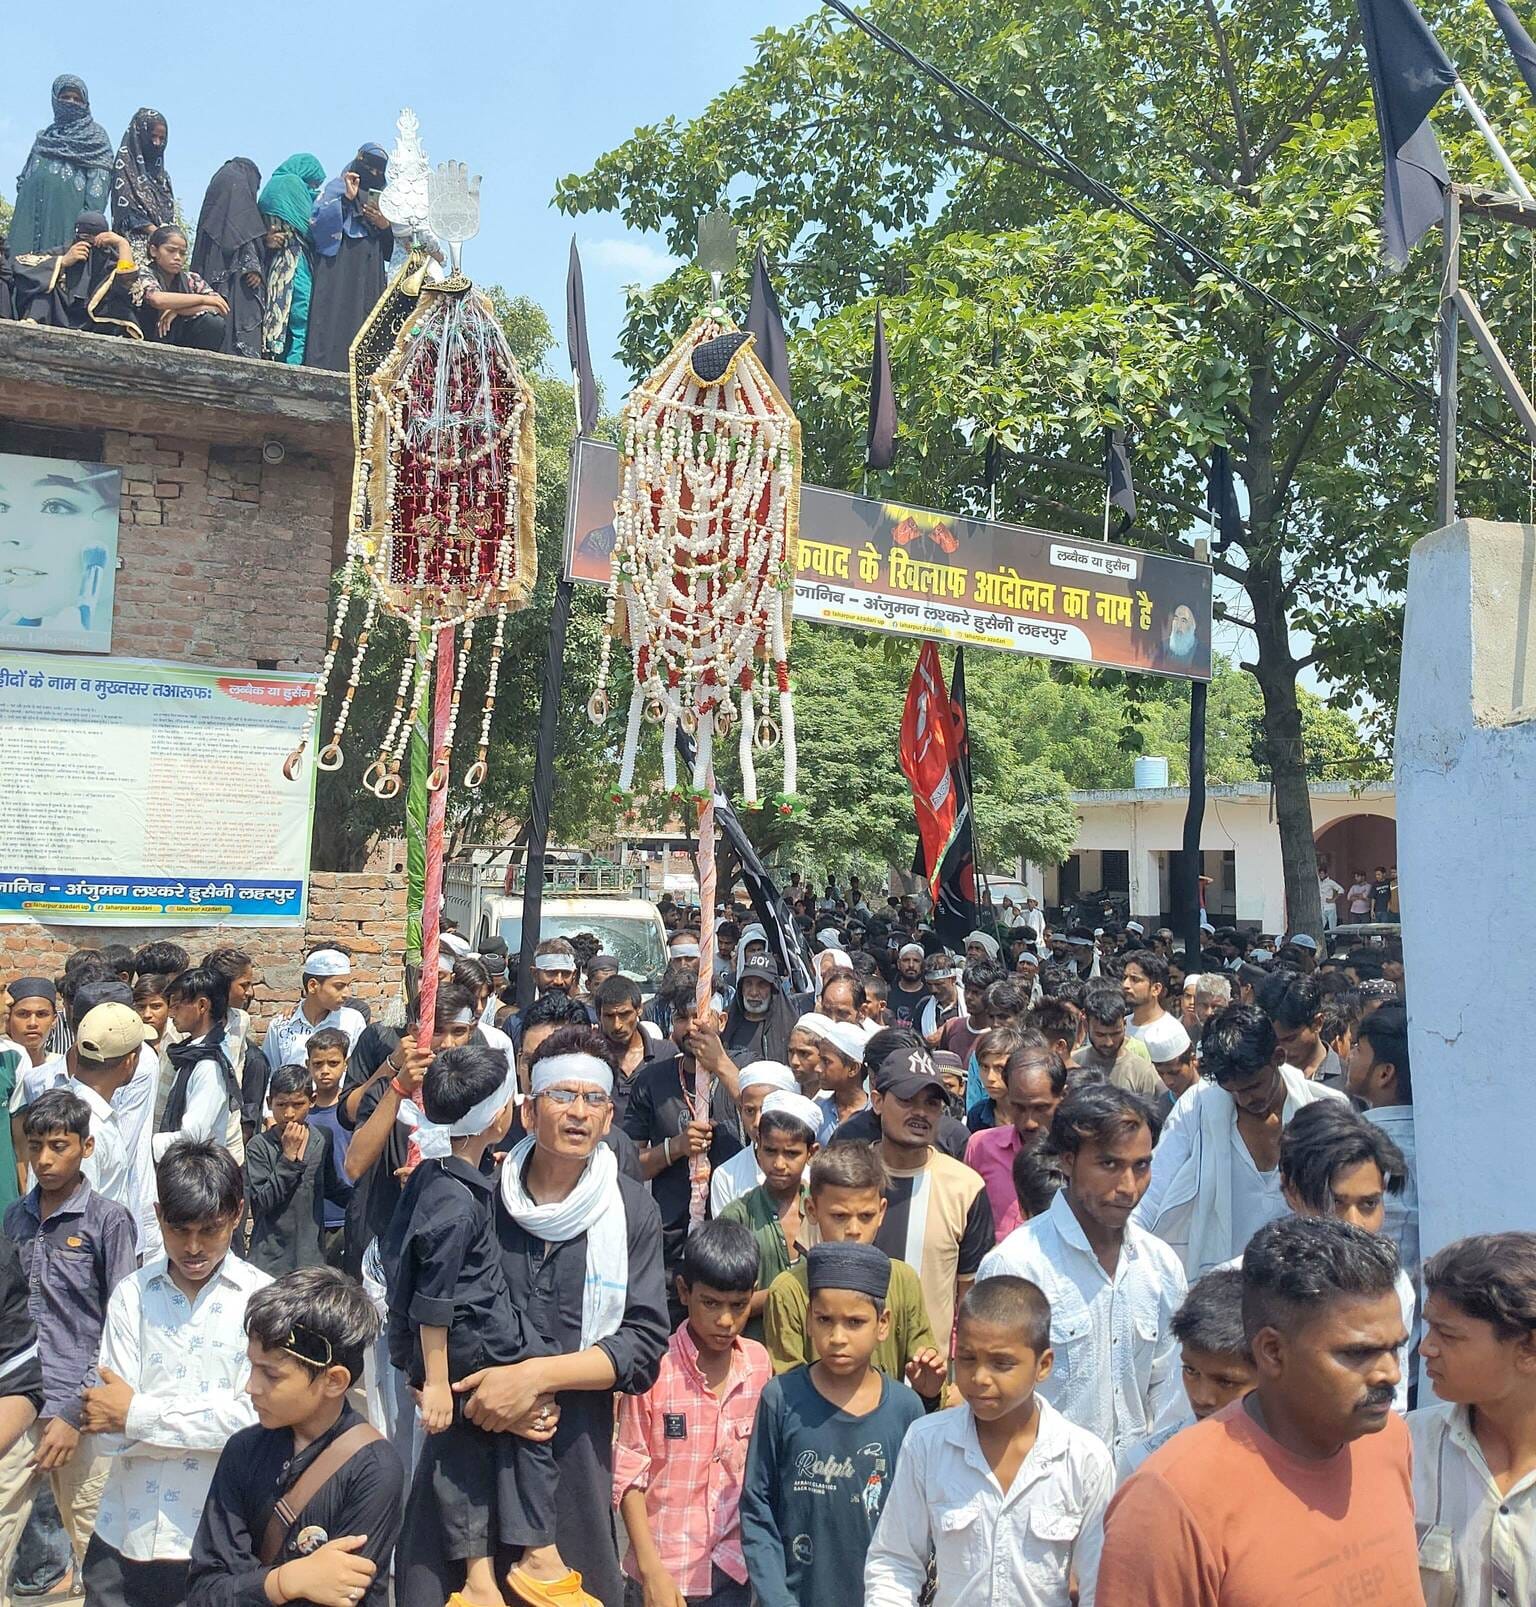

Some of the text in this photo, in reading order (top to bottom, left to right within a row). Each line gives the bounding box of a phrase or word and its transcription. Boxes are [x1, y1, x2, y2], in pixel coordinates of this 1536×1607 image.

[1091, 556, 1103, 567] या
[858, 542, 882, 583] के
[889, 547, 967, 598] खिलाफ
[974, 566, 1056, 614] आंदोलन
[1062, 586, 1090, 619] का
[1095, 592, 1133, 627] नाम
[1136, 591, 1153, 630] है
[795, 584, 845, 604] जानिब
[863, 595, 920, 619] अंजुमन
[923, 606, 972, 626] लश्करे
[1018, 622, 1068, 645] लहरपुर
[29, 672, 44, 688] के
[48, 676, 77, 690] नाम
[80, 678, 92, 692] व
[94, 679, 150, 700] मुख्तसर
[267, 687, 280, 696] या
[65, 880, 129, 901] अंजुमन
[132, 883, 186, 897] लश्करे
[239, 888, 296, 904] लहरपुर
[795, 1450, 855, 1483] Ralph
